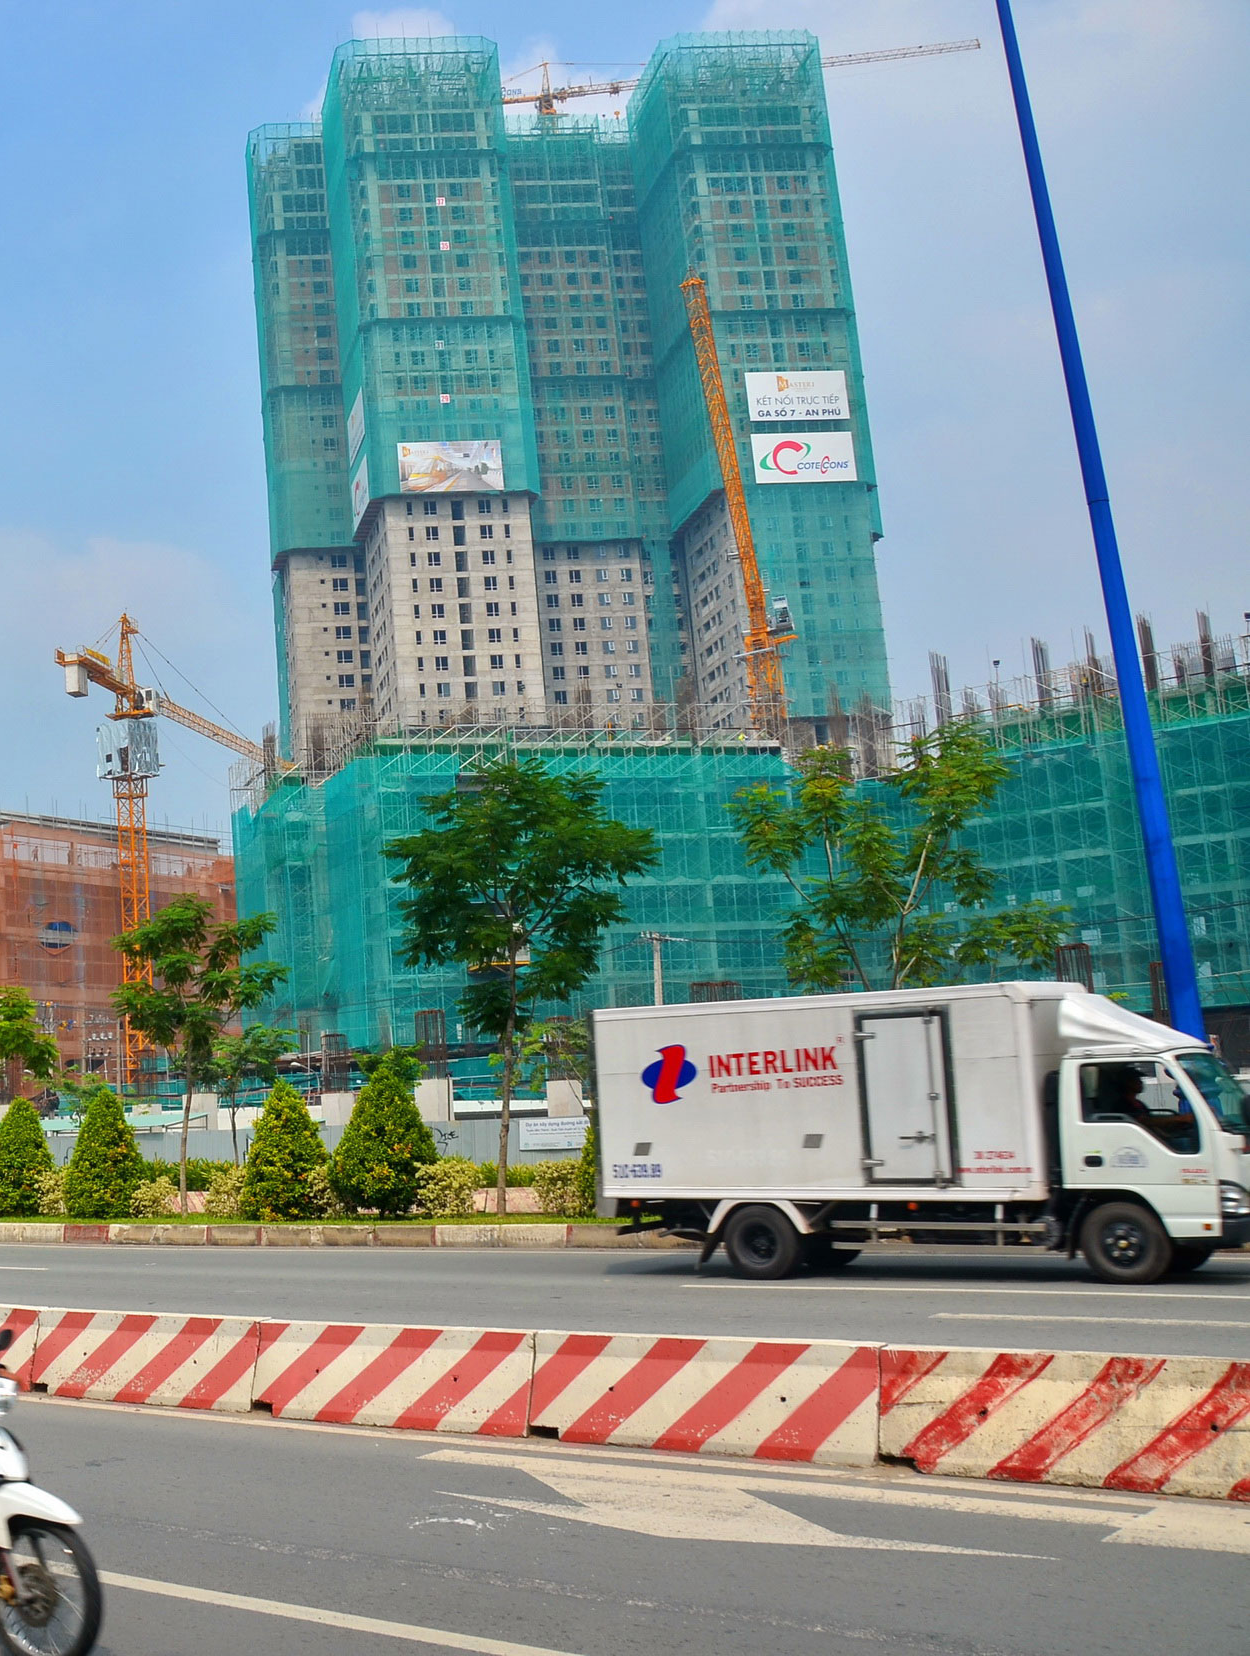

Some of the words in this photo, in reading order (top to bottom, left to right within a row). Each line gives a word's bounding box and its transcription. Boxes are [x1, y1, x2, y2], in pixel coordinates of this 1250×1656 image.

[775, 407, 787, 417] SỐ
[708, 1046, 838, 1078] INTERLINK
[711, 1080, 772, 1094] Partnership
[776, 1078, 790, 1088] To
[793, 1075, 844, 1089] SUCCESS
